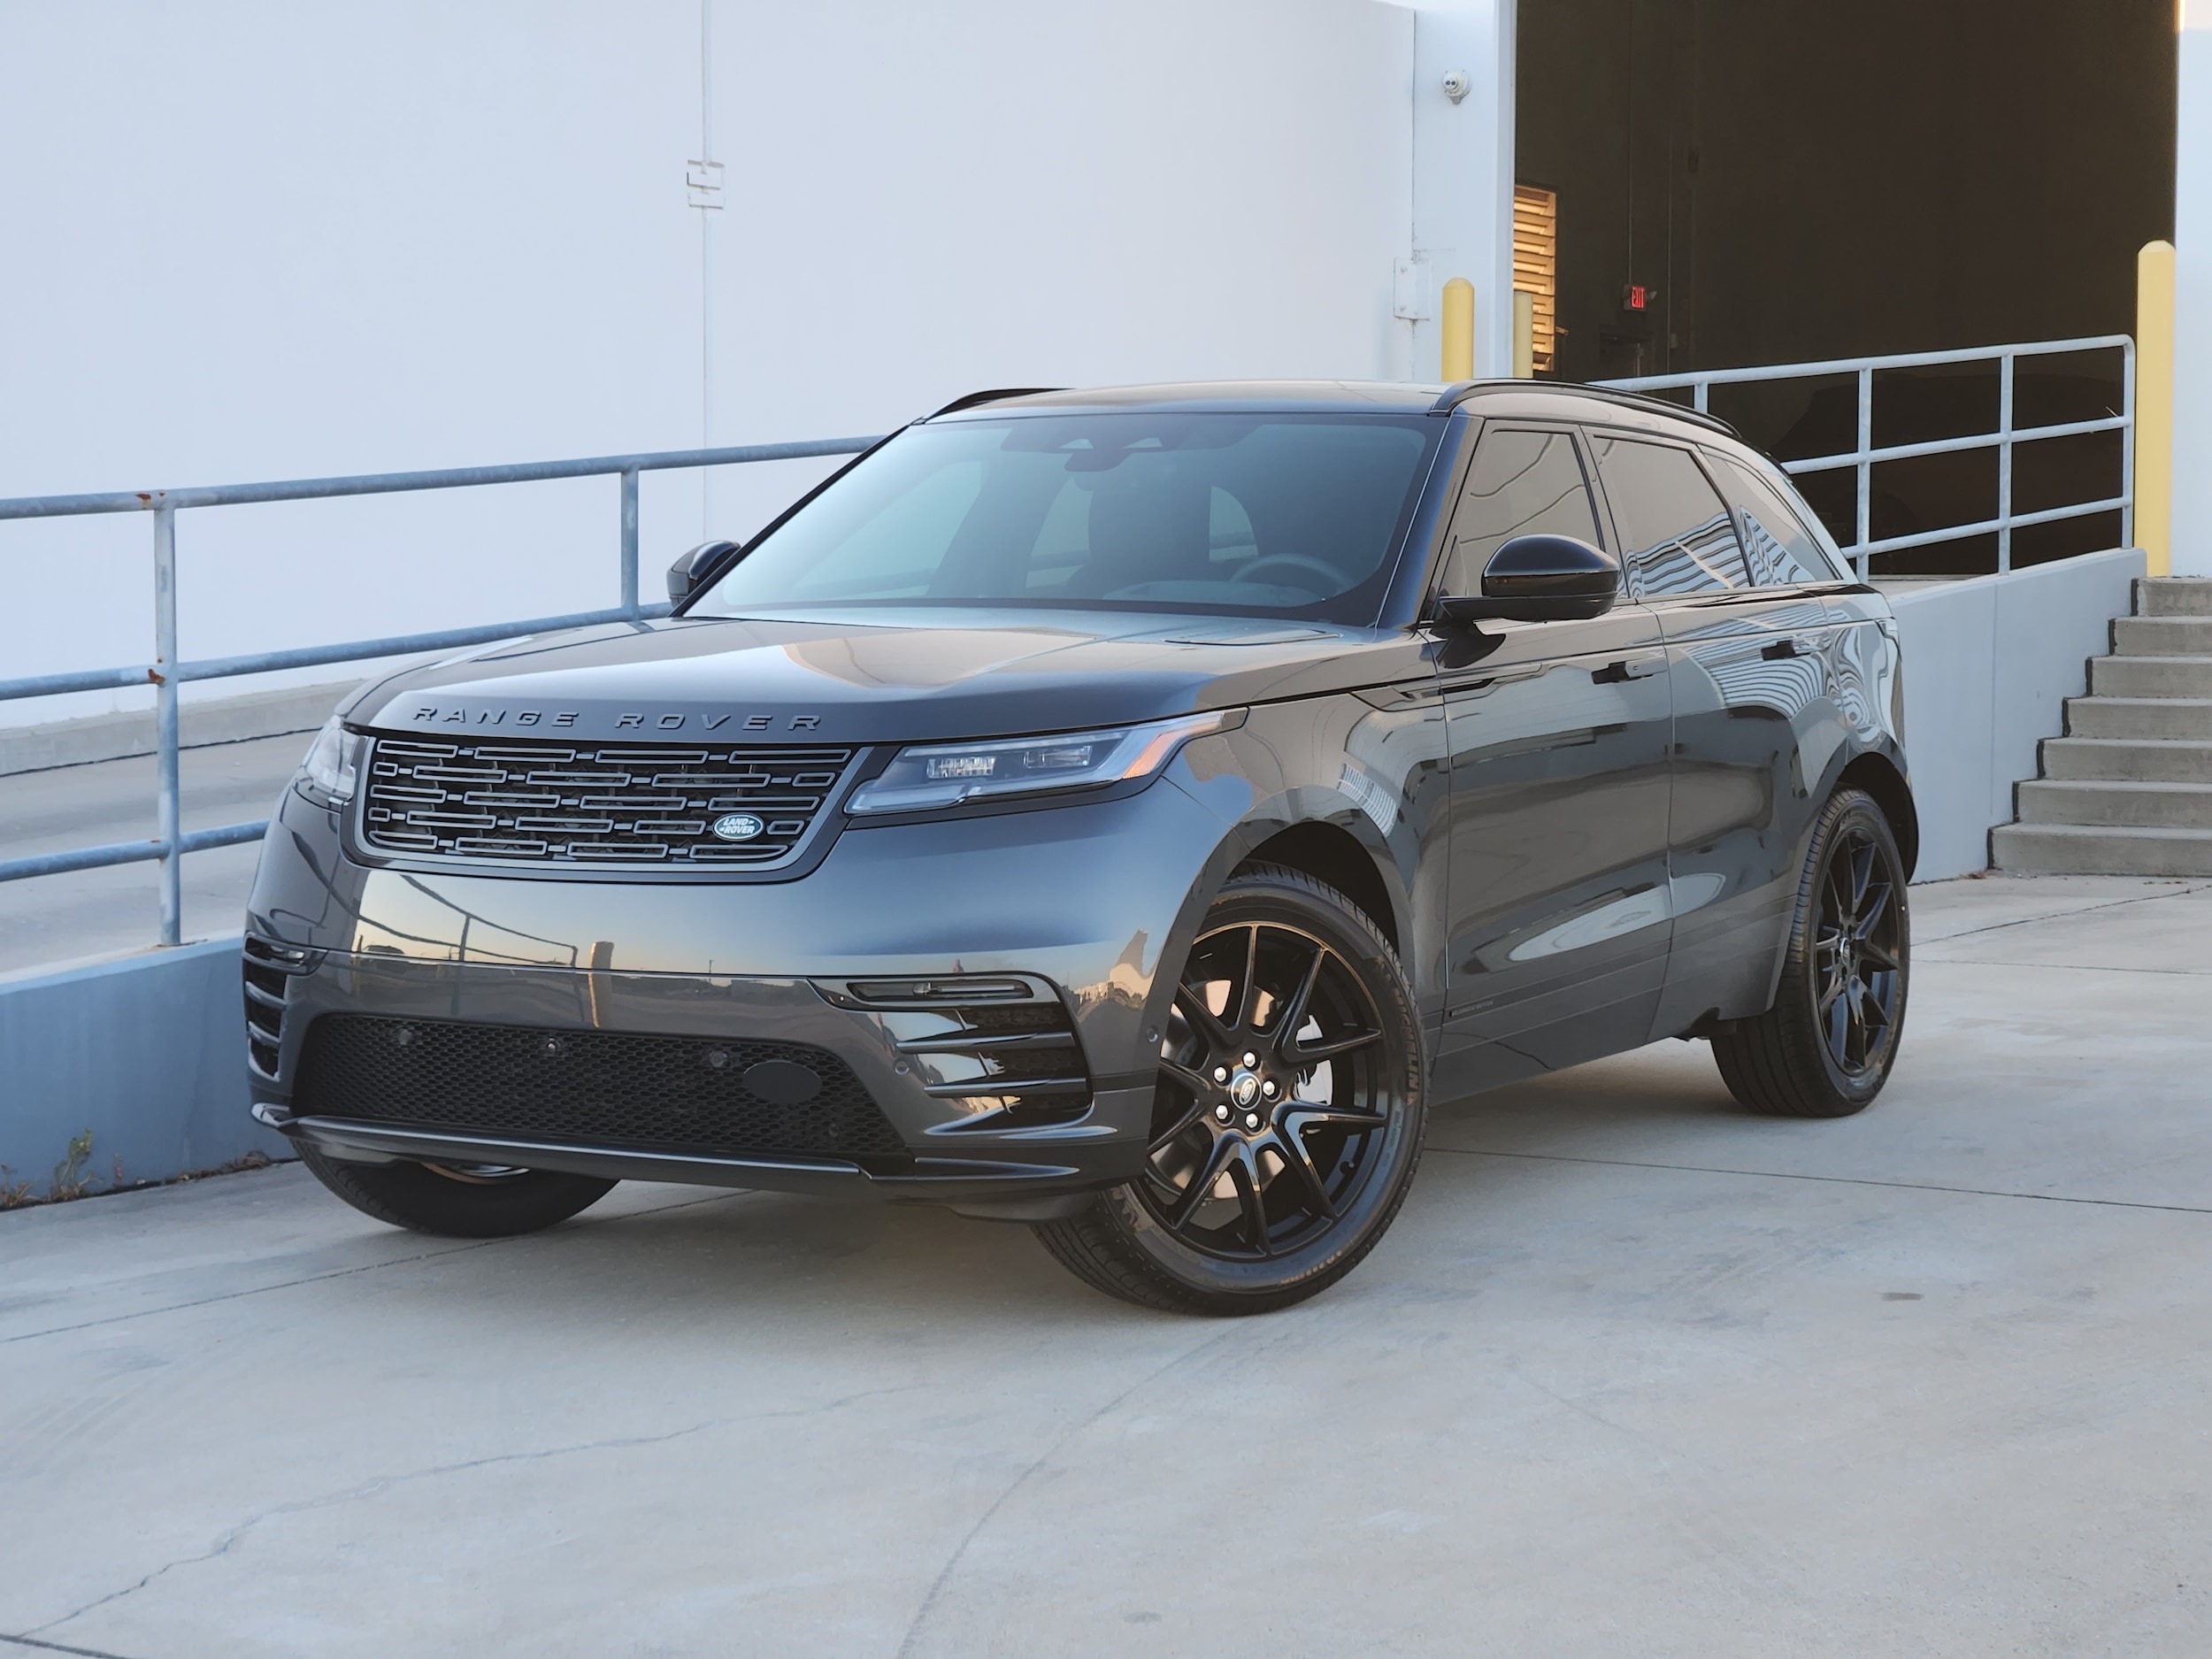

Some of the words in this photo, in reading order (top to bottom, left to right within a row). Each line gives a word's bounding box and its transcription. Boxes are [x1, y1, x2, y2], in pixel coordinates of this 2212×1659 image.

[1632, 287, 1644, 308] EXIT
[412, 707, 580, 727] RANGE
[614, 712, 821, 731] ROVER
[724, 826, 755, 834] ROVER
